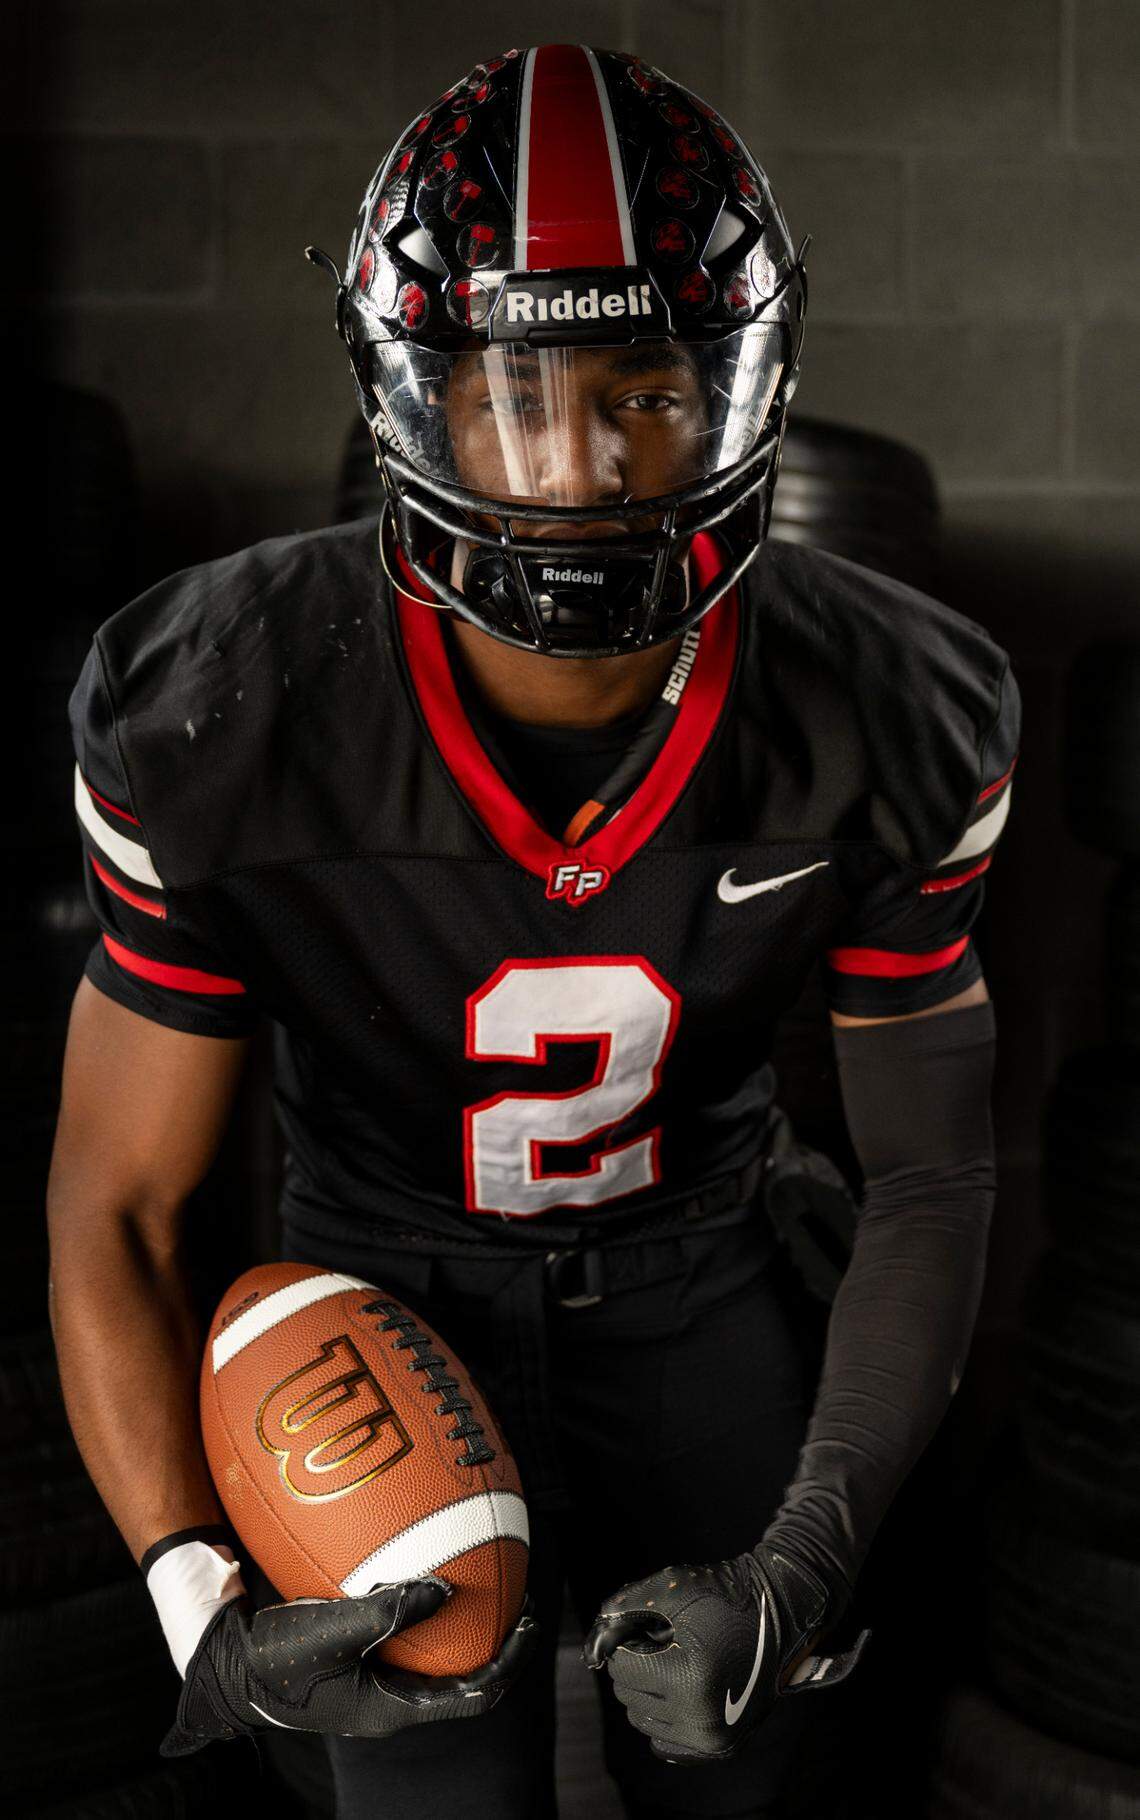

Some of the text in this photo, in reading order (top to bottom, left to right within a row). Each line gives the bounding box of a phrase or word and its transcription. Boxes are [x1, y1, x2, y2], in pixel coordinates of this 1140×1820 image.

[506, 284, 652, 323] Riddell
[542, 567, 604, 585] Riddell
[554, 864, 603, 896] FP
[462, 954, 682, 1219] 2
[255, 1333, 415, 1505] W
